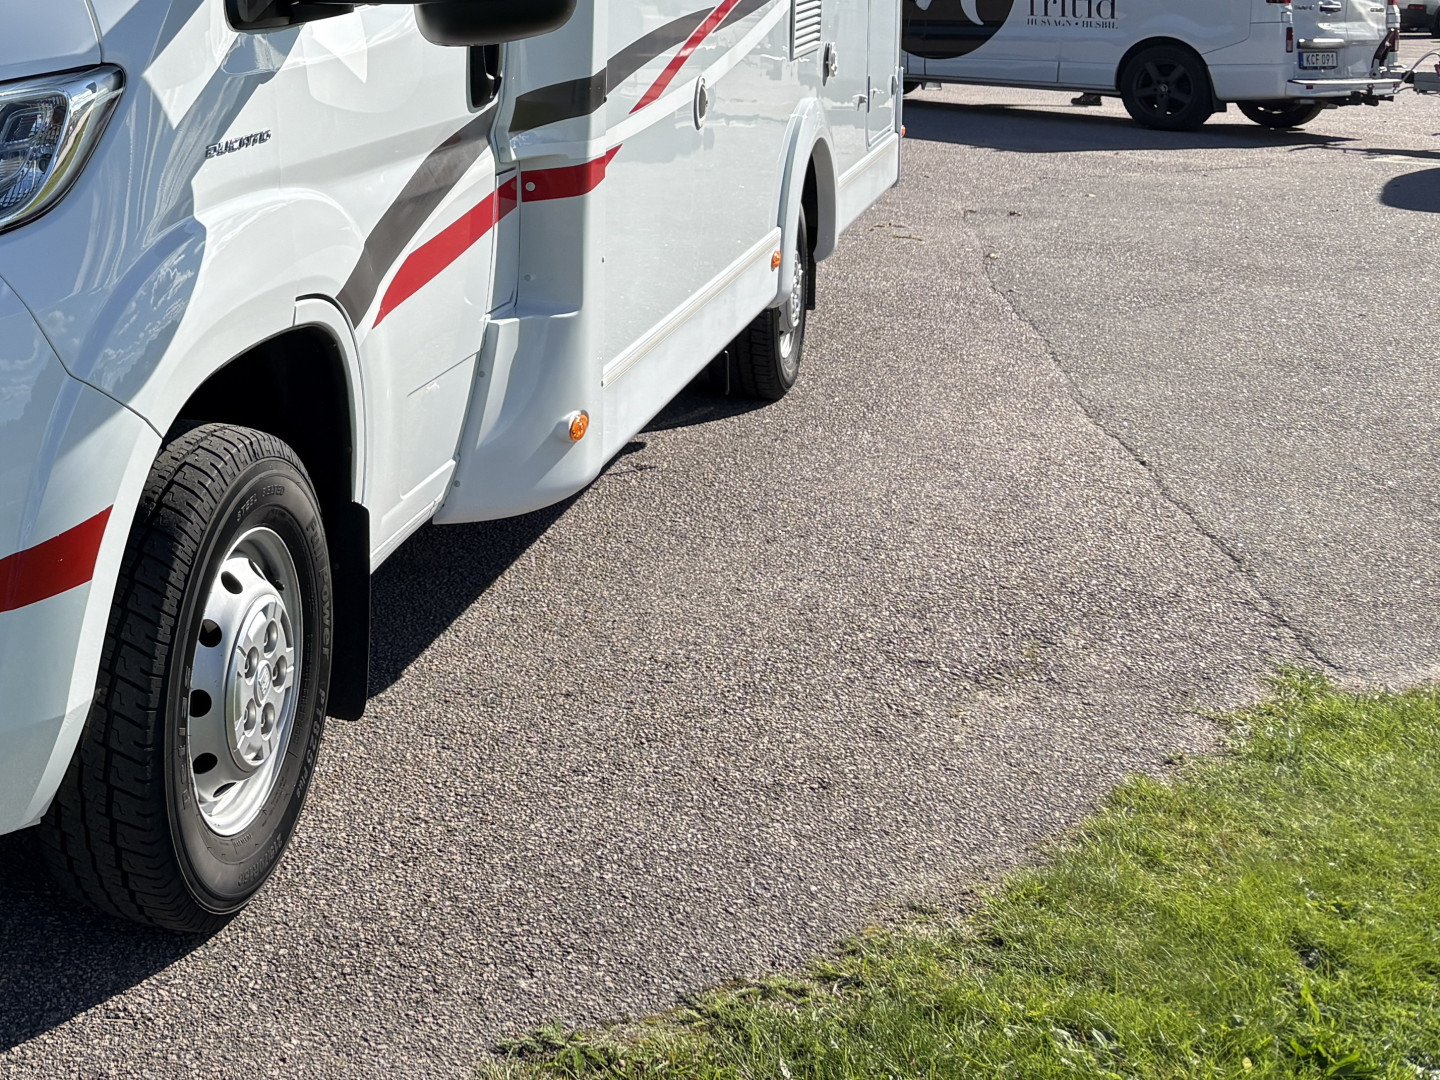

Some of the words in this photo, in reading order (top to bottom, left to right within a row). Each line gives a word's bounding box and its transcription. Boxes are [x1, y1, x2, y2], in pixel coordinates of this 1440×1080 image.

[1027, 18, 1072, 27] HUSVAGN
[1082, 20, 1119, 29] HUSBIL
[1305, 54, 1320, 65] KCF
[1321, 54, 1334, 65] 091
[318, 565, 331, 661] Power
